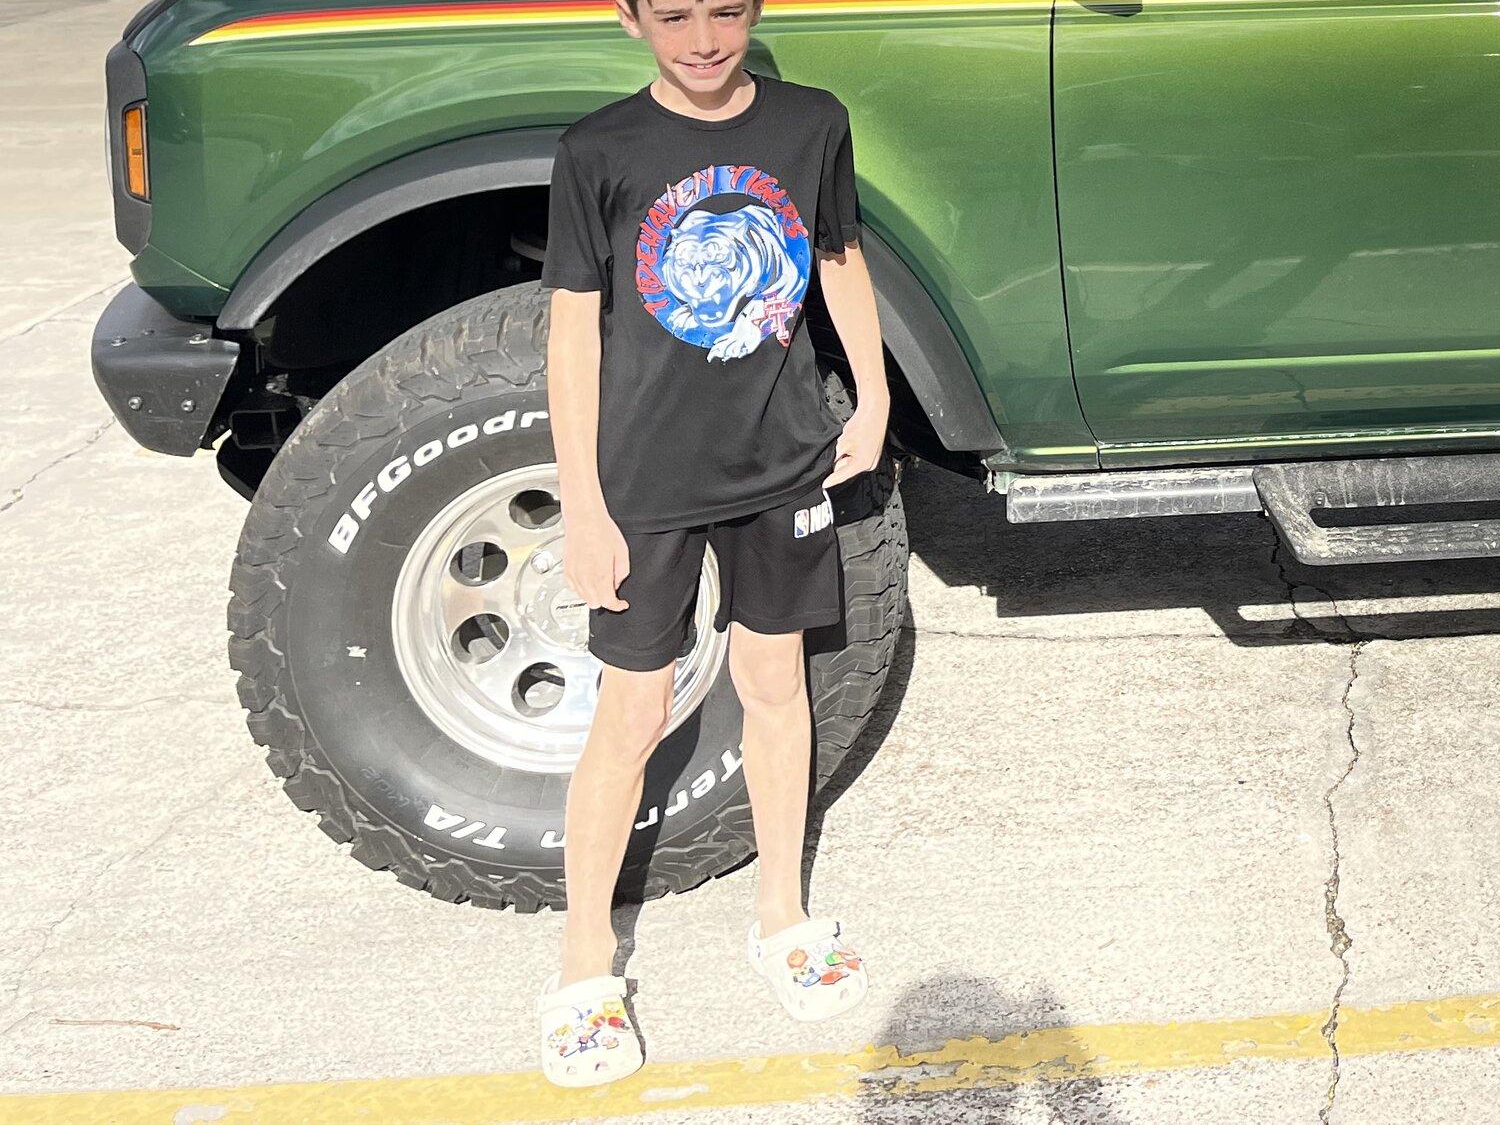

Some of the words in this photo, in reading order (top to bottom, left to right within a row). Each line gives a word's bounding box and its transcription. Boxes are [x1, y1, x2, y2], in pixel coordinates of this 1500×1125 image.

[727, 164, 809, 238] TIGERS
[327, 409, 549, 555] BFGoodr
[809, 501, 832, 534] NB
[424, 804, 508, 850] T/A
